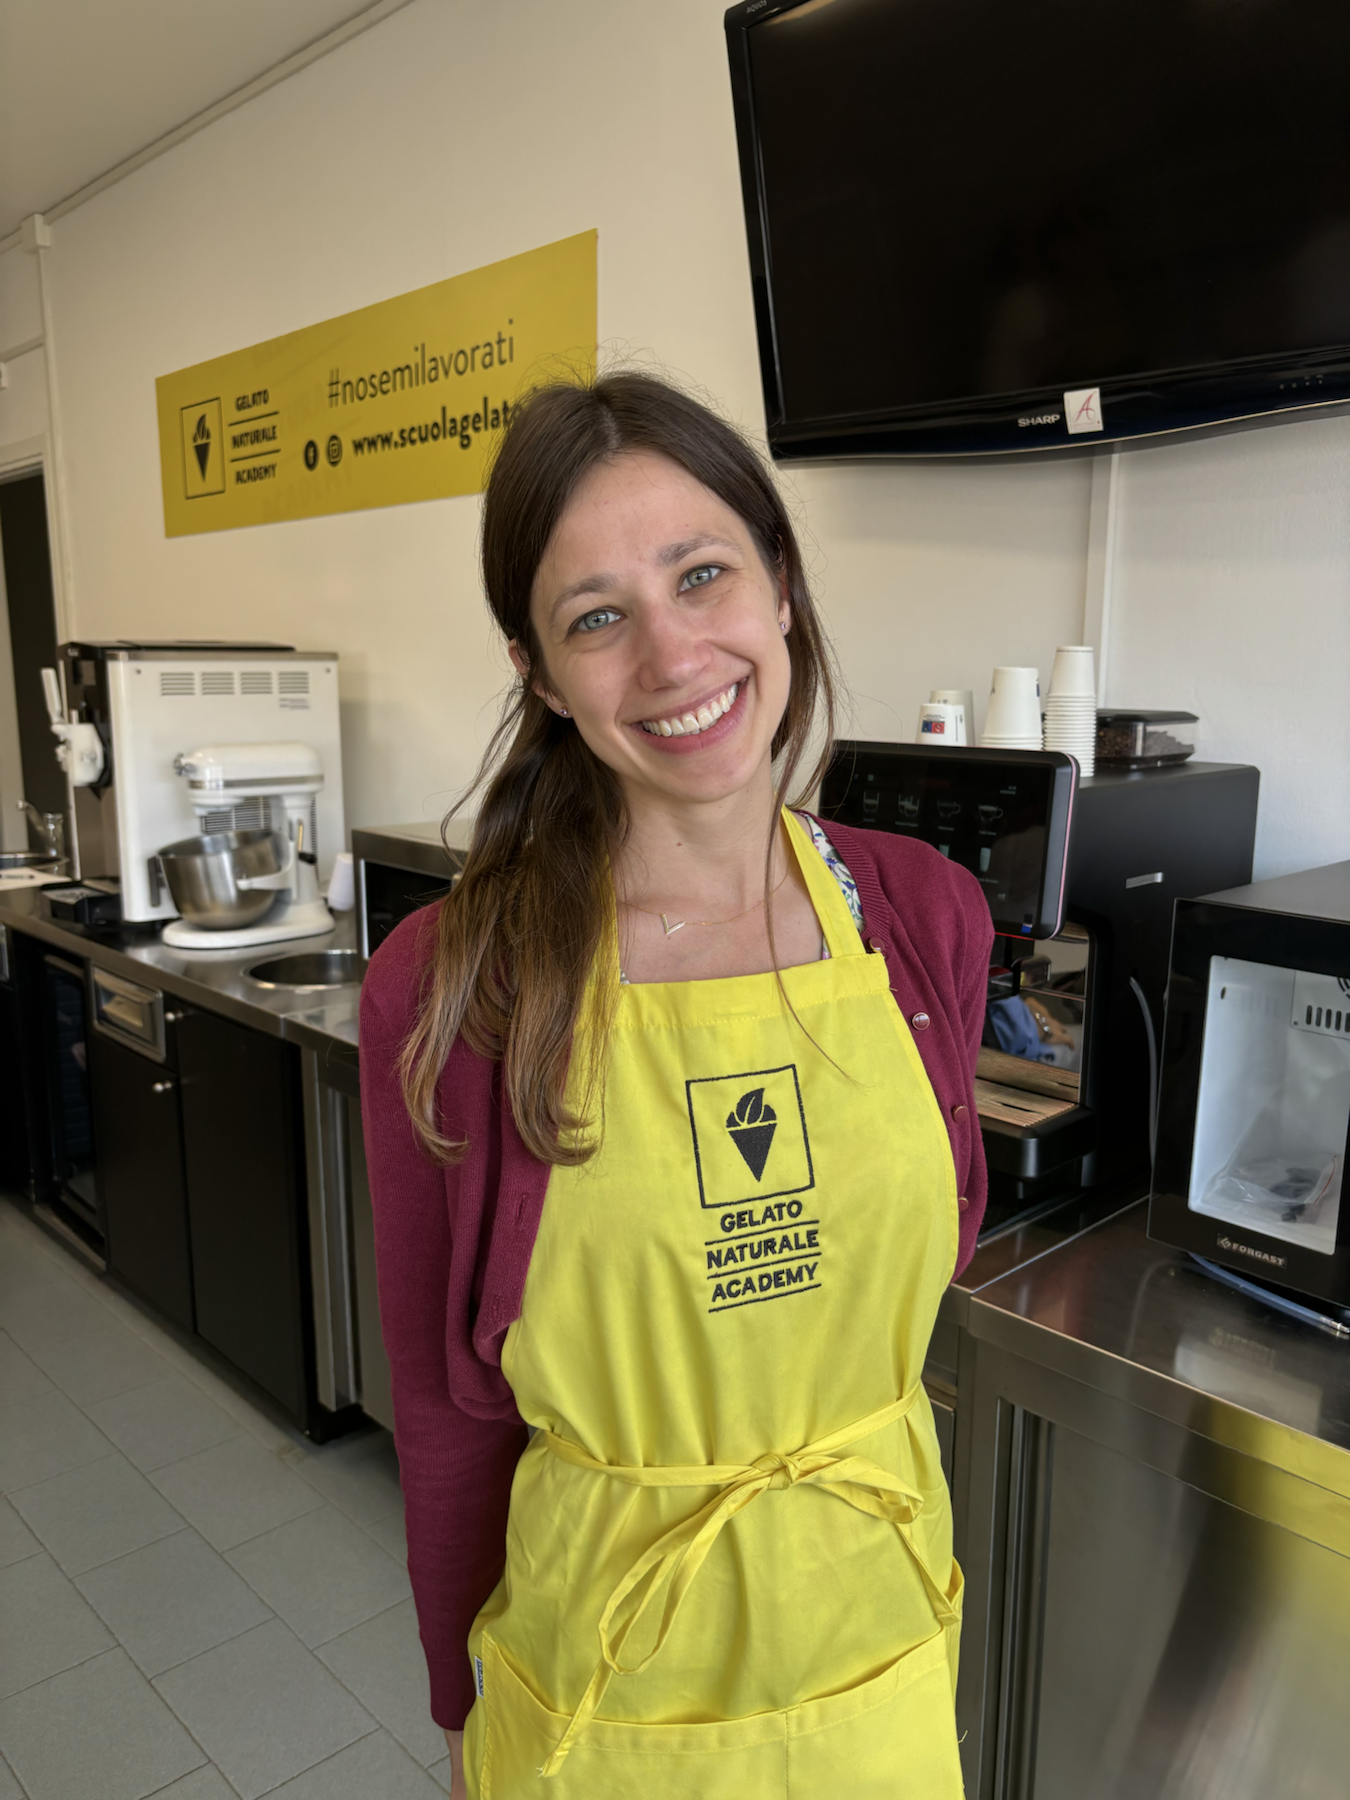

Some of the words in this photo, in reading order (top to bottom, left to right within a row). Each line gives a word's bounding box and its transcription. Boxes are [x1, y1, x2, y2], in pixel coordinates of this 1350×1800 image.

[328, 320, 513, 406] #nosemilavorati
[236, 390, 269, 411] GELATO
[1018, 414, 1060, 427] SHARP
[232, 426, 277, 449] NATURALE
[236, 463, 277, 484] ACADEMY
[720, 1200, 803, 1233] GELATO
[707, 1230, 819, 1269] NATURALE
[1233, 1243, 1284, 1266] FORGAST
[712, 1263, 818, 1302] ACADEMY
